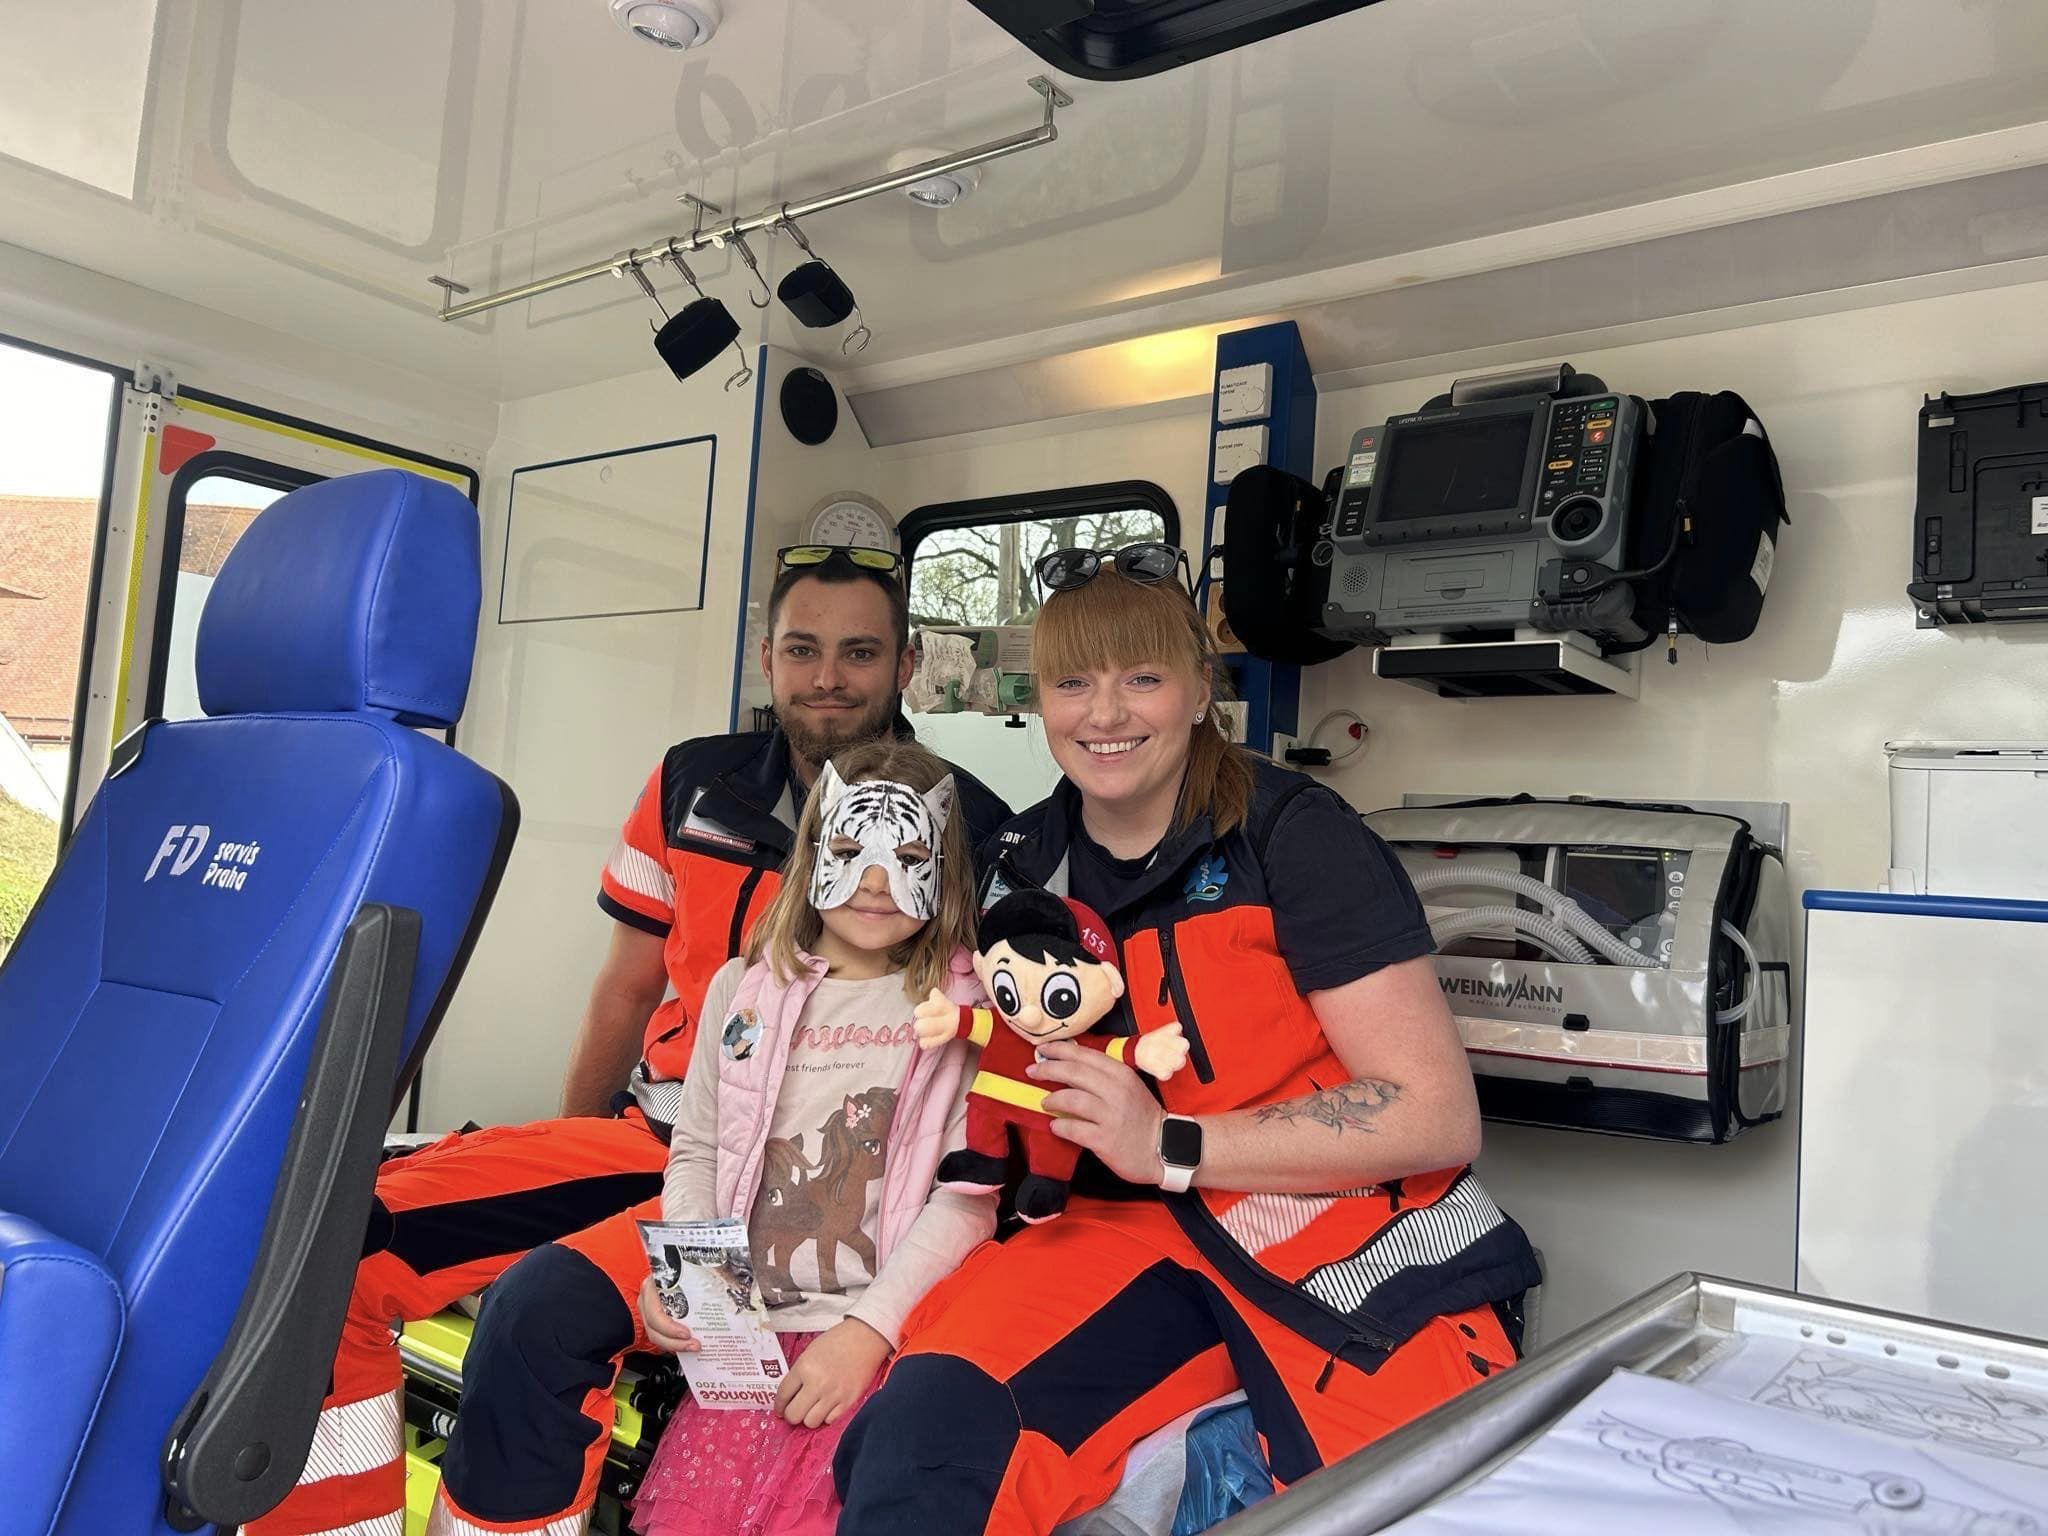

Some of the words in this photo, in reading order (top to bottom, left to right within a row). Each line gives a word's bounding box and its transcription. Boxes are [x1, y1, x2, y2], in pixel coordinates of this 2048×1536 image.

[144, 825, 210, 882] FD
[214, 841, 260, 865] servis
[202, 862, 248, 891] Praha
[1082, 927, 1108, 954] 155
[1438, 973, 1562, 1007] WEINMANN
[1469, 998, 1504, 1008] medical
[1514, 1003, 1562, 1014] technology
[786, 1064, 800, 1072] est
[801, 1063, 831, 1073] friends
[832, 1061, 865, 1070] forever
[700, 1390, 777, 1405] elikonoce
